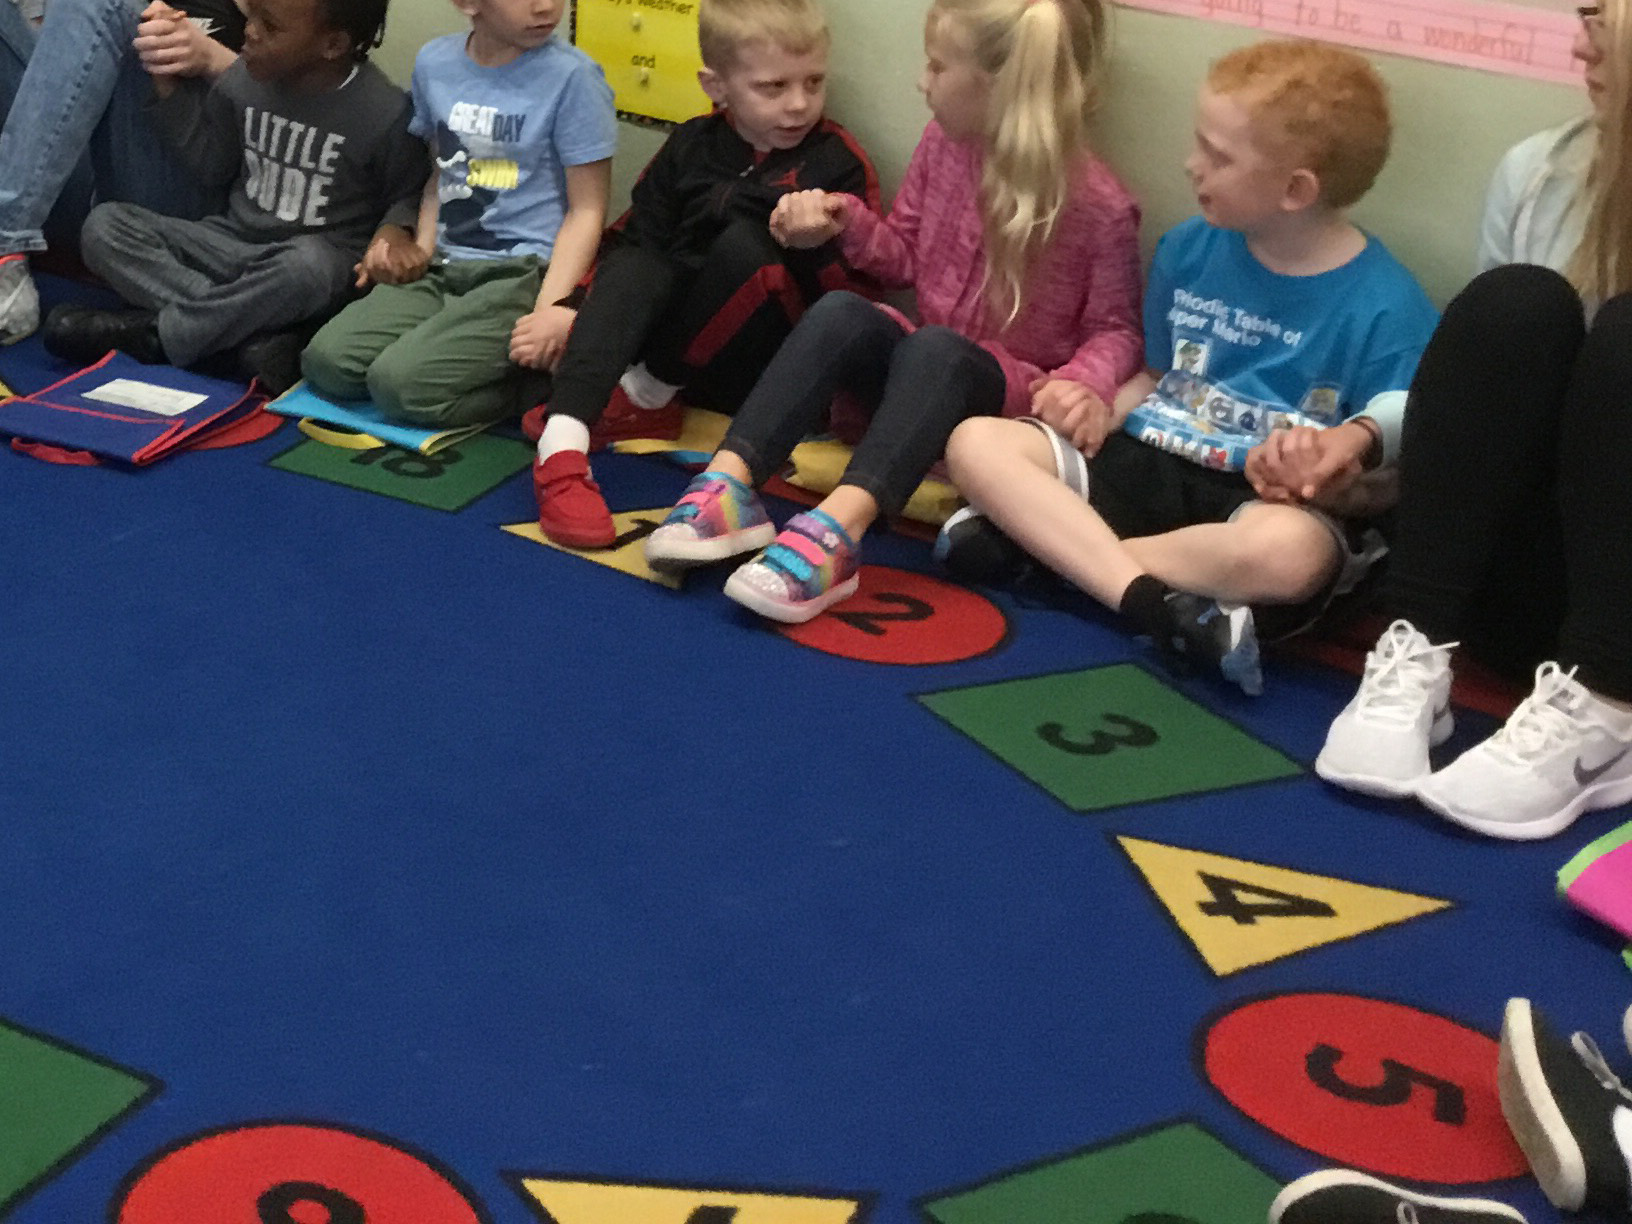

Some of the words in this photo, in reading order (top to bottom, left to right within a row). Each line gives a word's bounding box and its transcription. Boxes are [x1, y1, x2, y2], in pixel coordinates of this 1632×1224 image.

[1385, 19, 1404, 43] a
[631, 53, 656, 69] and
[244, 106, 347, 174] LITTLE
[492, 113, 527, 143] DAY
[1282, 329, 1304, 347] of
[834, 590, 936, 638] 2
[1035, 712, 1161, 757] 3
[1194, 870, 1338, 926] 4
[1304, 1042, 1469, 1127] 5
